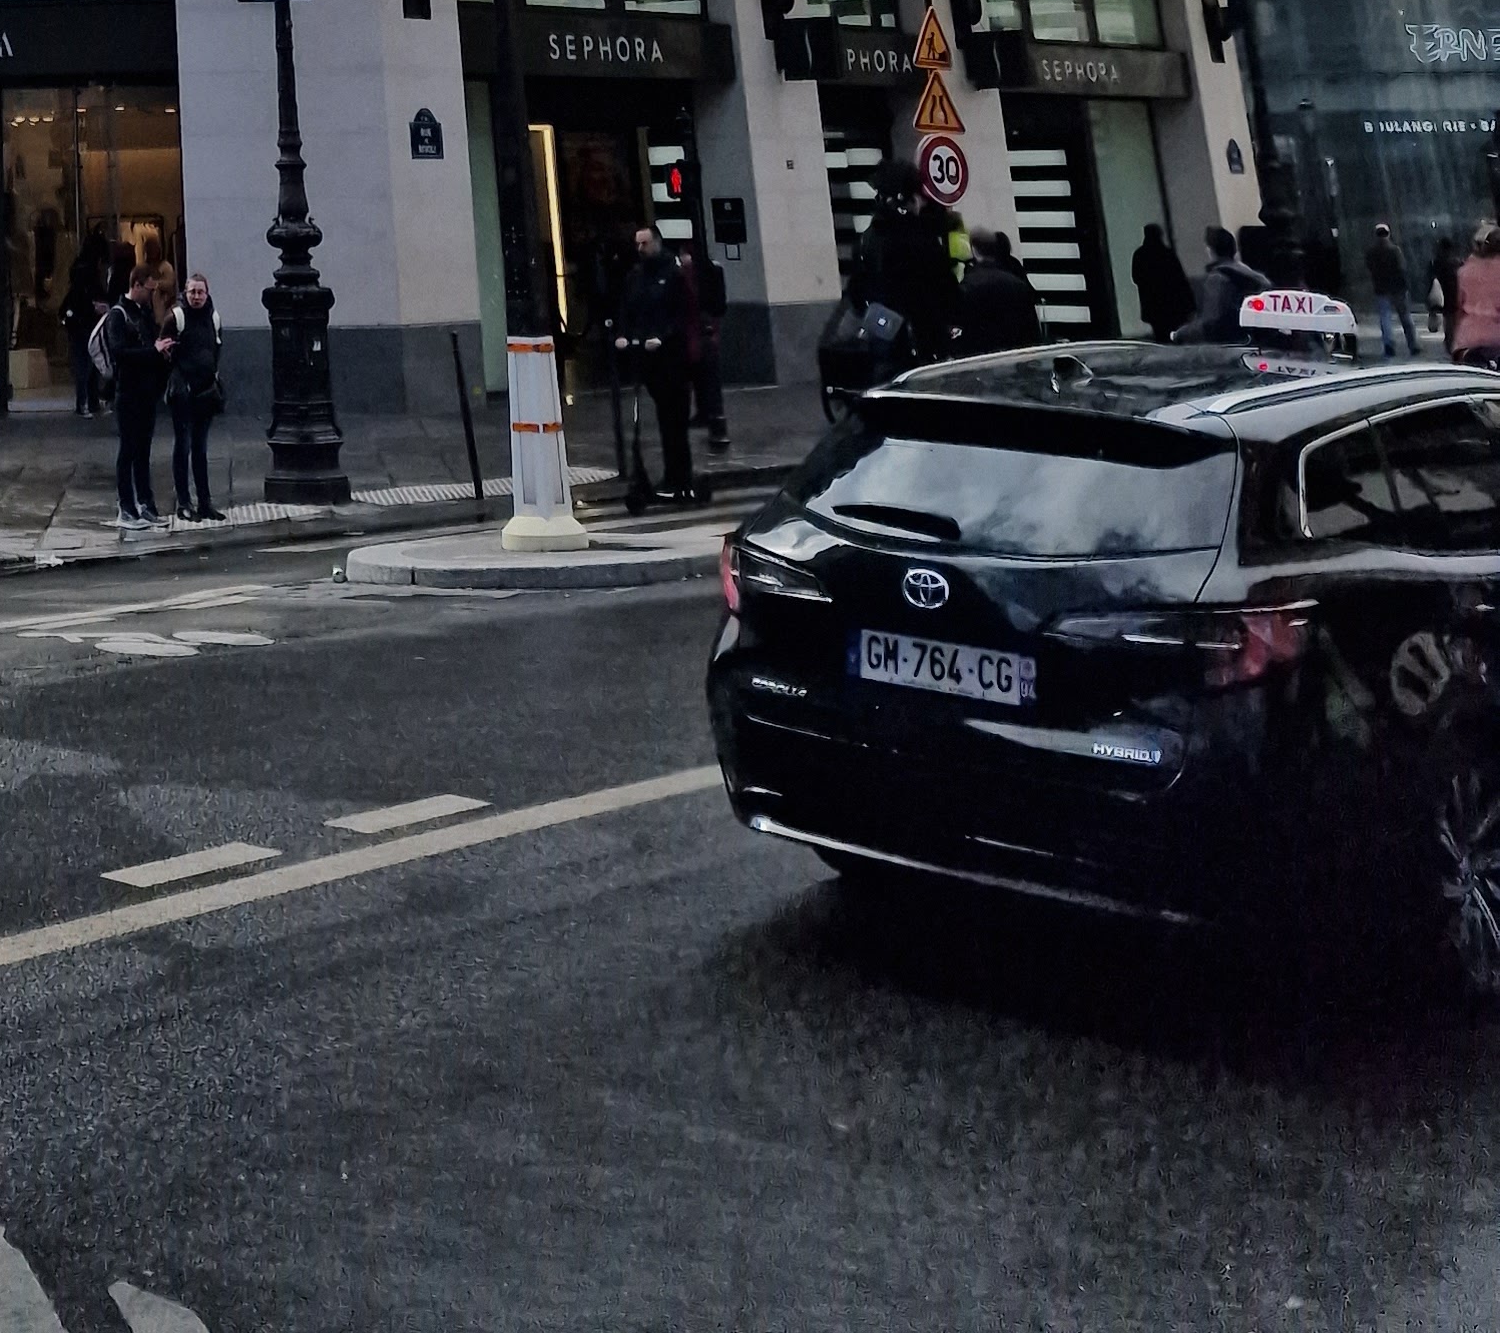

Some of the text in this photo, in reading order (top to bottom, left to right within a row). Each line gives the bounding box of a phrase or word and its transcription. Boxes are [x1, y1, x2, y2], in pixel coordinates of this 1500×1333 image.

[548, 34, 664, 62] SEPHORA
[1041, 59, 1121, 83] SEPHORA
[932, 154, 960, 185] 30
[1268, 295, 1313, 314] TAXI
[866, 635, 1013, 694] GM-764-CG
[1093, 742, 1150, 761] HYBRID
